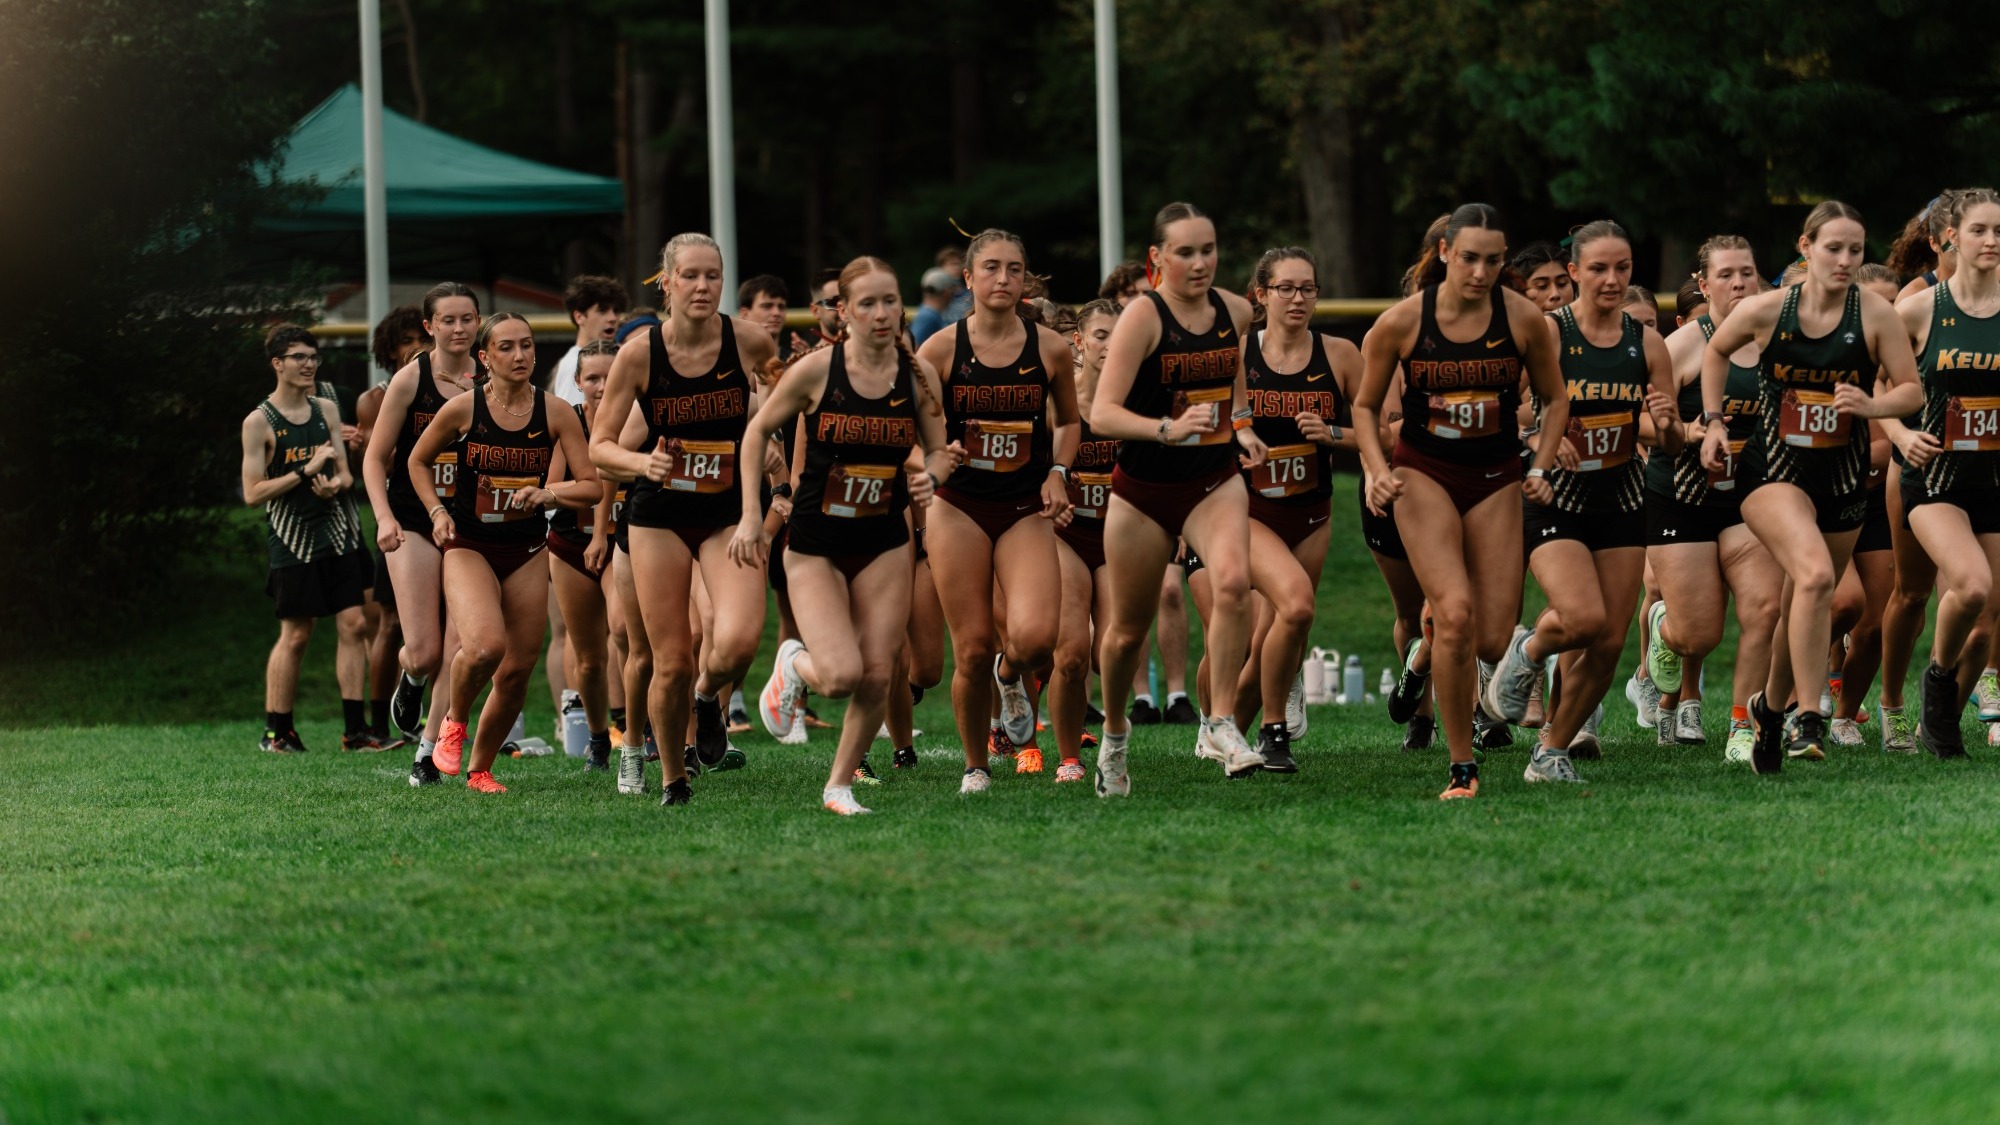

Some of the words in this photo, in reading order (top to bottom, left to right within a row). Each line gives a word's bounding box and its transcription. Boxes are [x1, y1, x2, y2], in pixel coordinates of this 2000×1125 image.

[1936, 348, 2000, 371] KEUK
[1410, 358, 1518, 388] FISHER
[1774, 363, 1859, 384] KEUKA
[953, 385, 1041, 412] FISHER
[1567, 379, 1642, 401] KEUKA
[652, 388, 744, 425] FISHER
[1446, 402, 1485, 428] 181
[1797, 404, 1838, 433] 138
[817, 412, 914, 447] FISHER
[1961, 409, 1998, 436] 134
[980, 433, 1017, 458] 185
[1583, 426, 1622, 455] 137
[285, 446, 320, 463] KEU
[467, 442, 549, 472] FISHER
[682, 453, 720, 479] 184
[433, 463, 457, 484] 18
[1267, 457, 1305, 483] 176
[844, 477, 883, 504] 178
